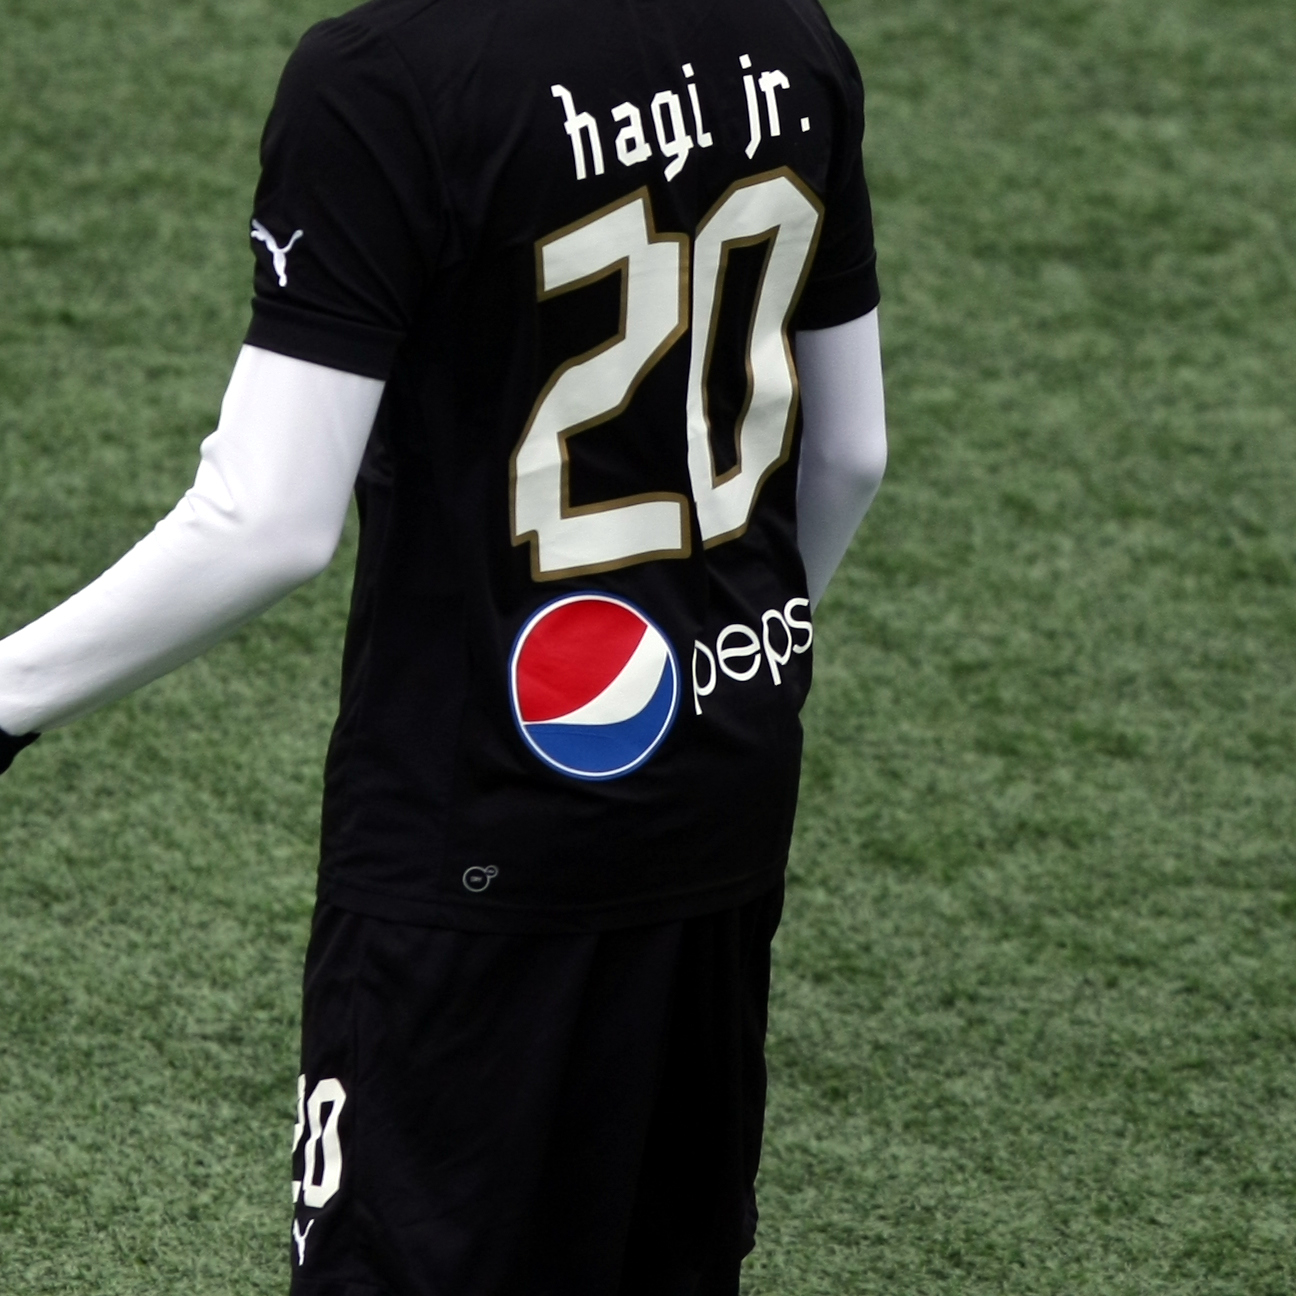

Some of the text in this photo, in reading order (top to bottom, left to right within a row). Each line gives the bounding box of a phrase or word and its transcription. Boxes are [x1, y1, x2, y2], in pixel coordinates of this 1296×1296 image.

[551, 53, 811, 182] hagi jr.
[509, 165, 825, 582] 20
